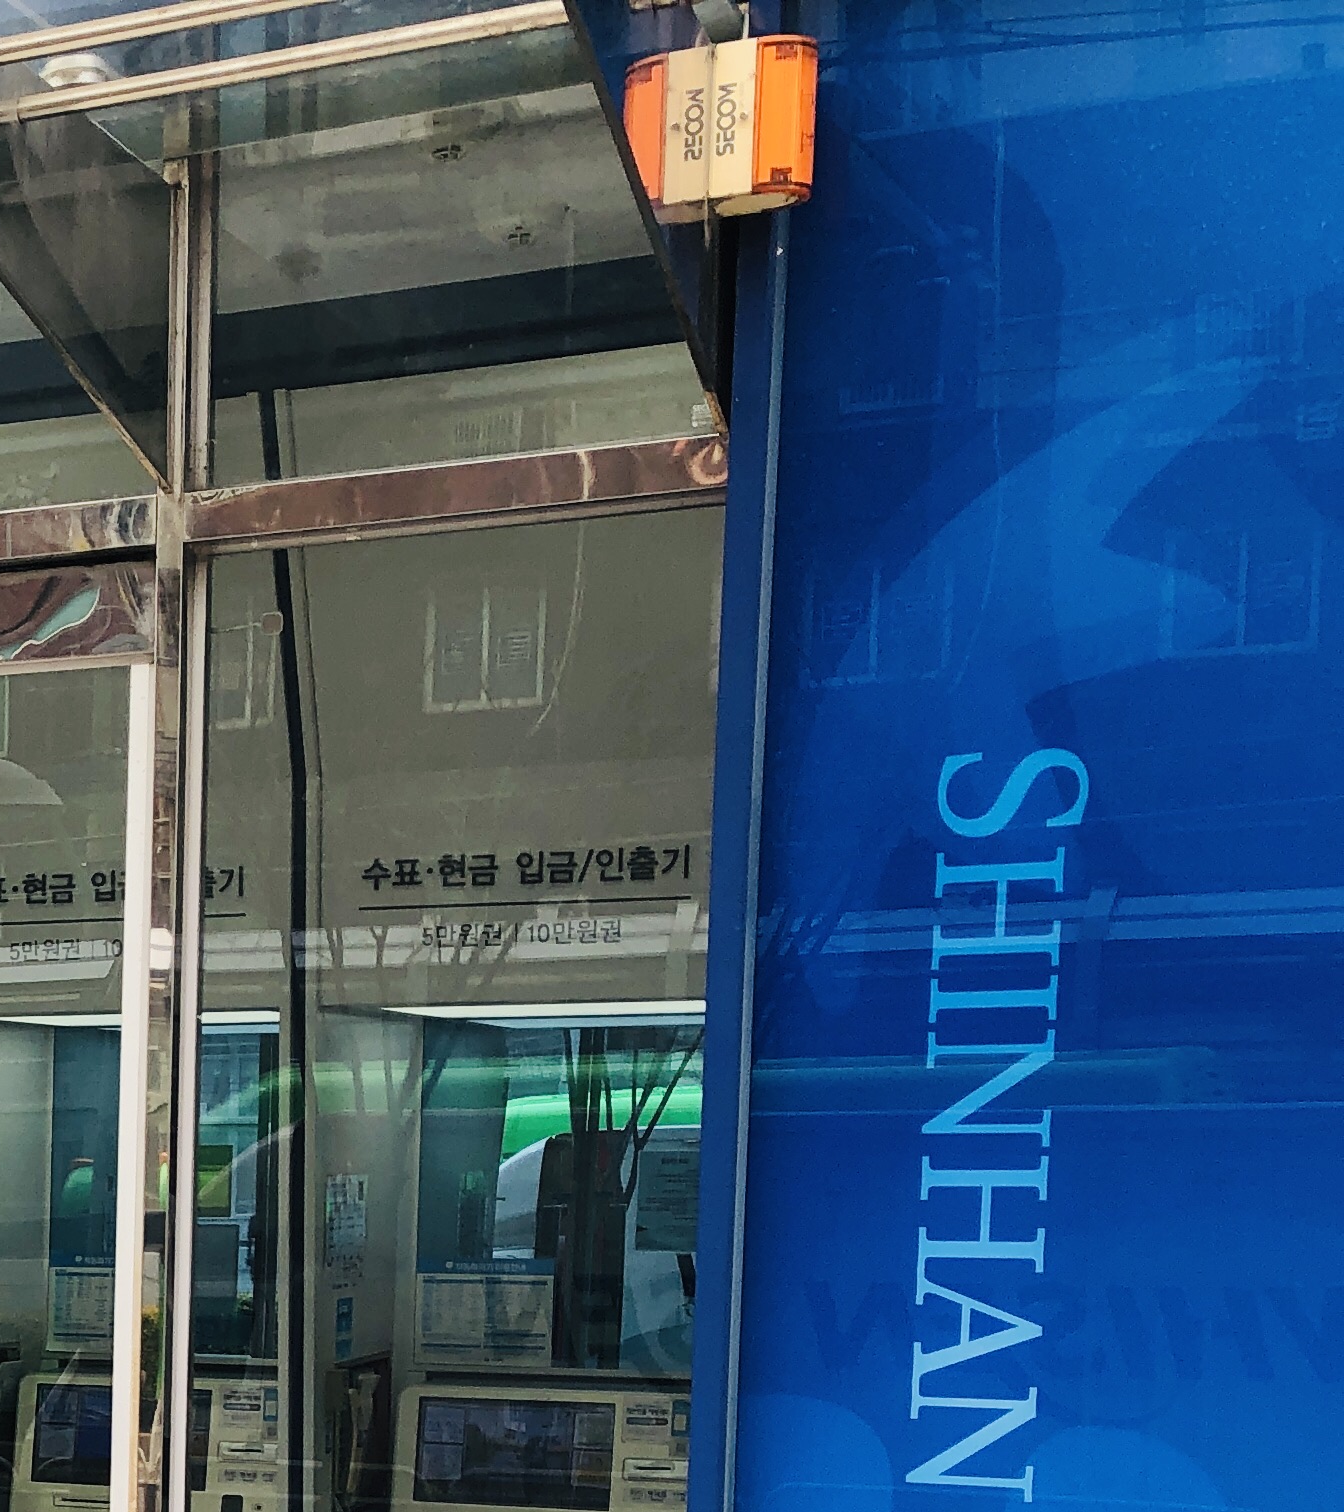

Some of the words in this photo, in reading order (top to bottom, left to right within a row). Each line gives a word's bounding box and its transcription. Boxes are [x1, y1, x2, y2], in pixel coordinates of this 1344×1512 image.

[715, 83, 738, 157] SECOM
[362, 853, 499, 891] 수표·현금
[516, 844, 692, 884] 입금/인출기
[9, 938, 82, 962] 5만원권
[421, 923, 503, 948] 5만원권
[527, 918, 623, 945] 10만원권
[906, 746, 1090, 1504] SHINHAN
